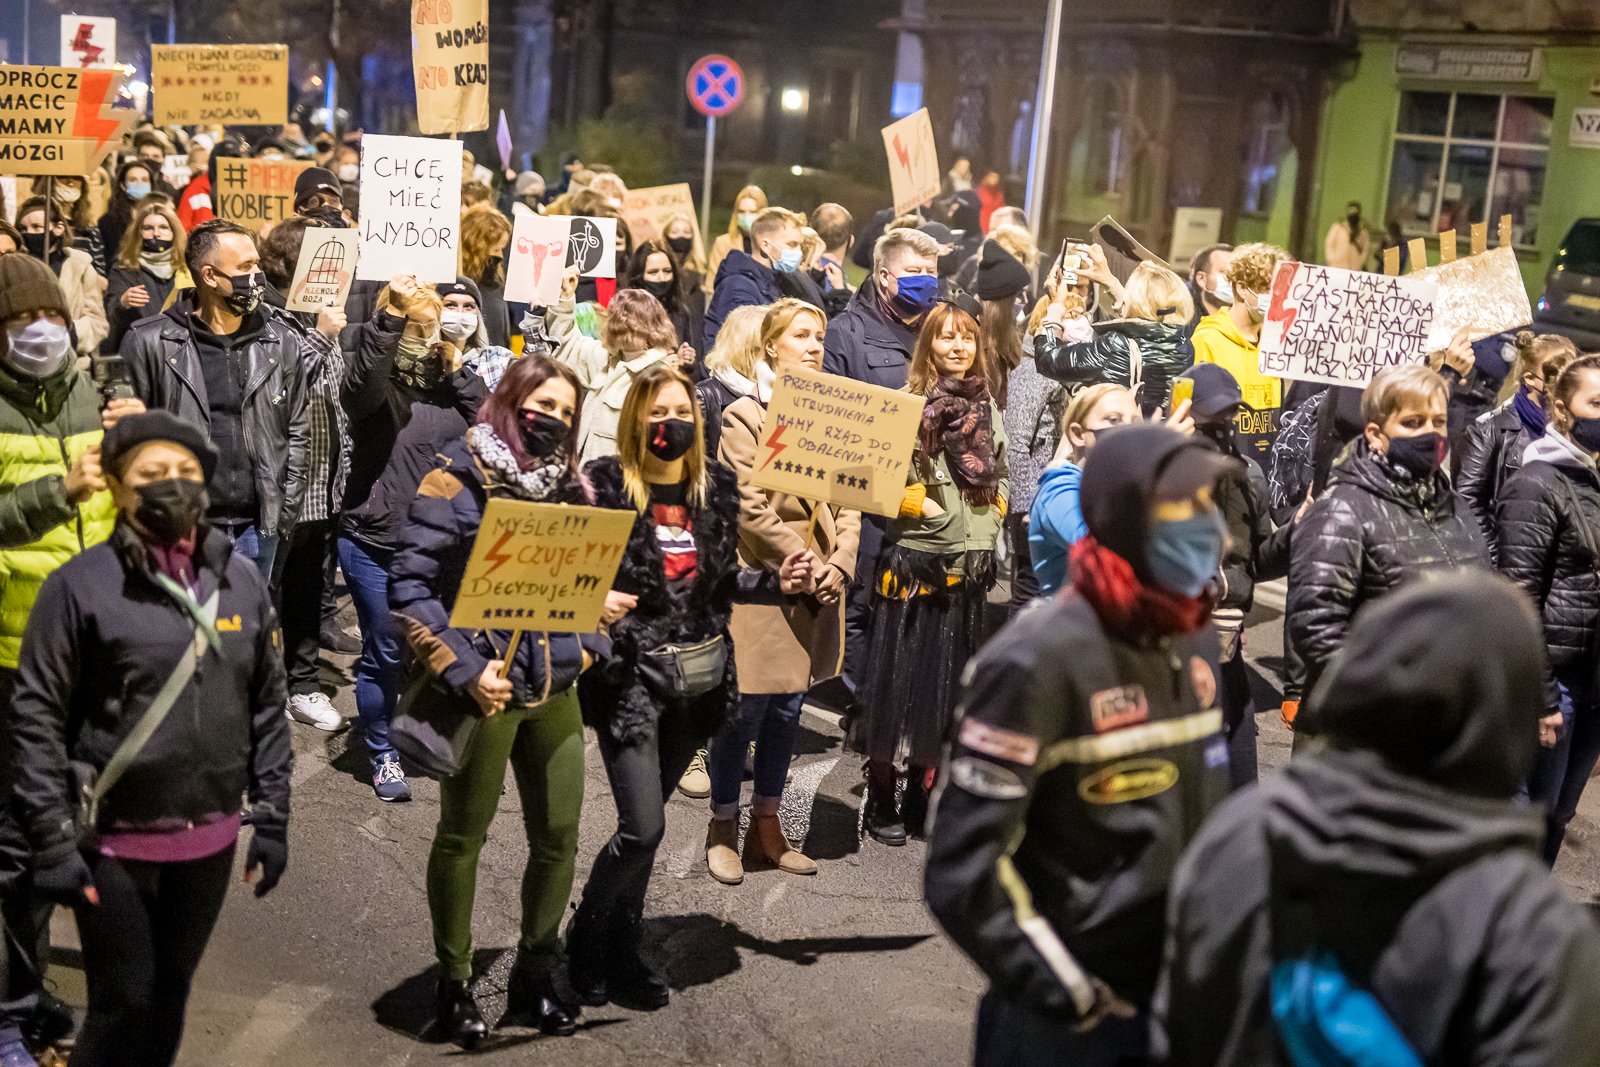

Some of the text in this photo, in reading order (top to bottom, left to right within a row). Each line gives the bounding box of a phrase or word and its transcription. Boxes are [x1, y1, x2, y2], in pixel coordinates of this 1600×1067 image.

[416, 0, 453, 25] NO
[157, 50, 195, 62] NIECH
[200, 50, 229, 61] WAM
[0, 67, 78, 89] OPRÓCZ
[419, 63, 488, 90] NO KRAJ
[0, 94, 65, 110] MACIC
[0, 118, 66, 134] MAMY
[166, 110, 189, 121] NIE
[0, 140, 64, 161] MÓZGI
[374, 156, 444, 182] CHCĘ
[220, 194, 289, 221] KOBIET
[389, 186, 443, 210] MIEĆ
[365, 217, 452, 250] WYBÓR
[304, 286, 341, 296] NIEWOLA
[1303, 264, 1403, 296] TA MAŁA
[1379, 293, 1434, 321] KTÓRA
[1298, 302, 1433, 338] MI ZABIERACIE
[1289, 320, 1369, 346] STANOWI
[1258, 350, 1296, 374] JEST
[1283, 336, 1337, 364] MOJEJ
[793, 396, 875, 425] UTRUDNIENIA
[880, 400, 900, 416] ZA
[776, 413, 892, 451] MAMY RZĄD DO
